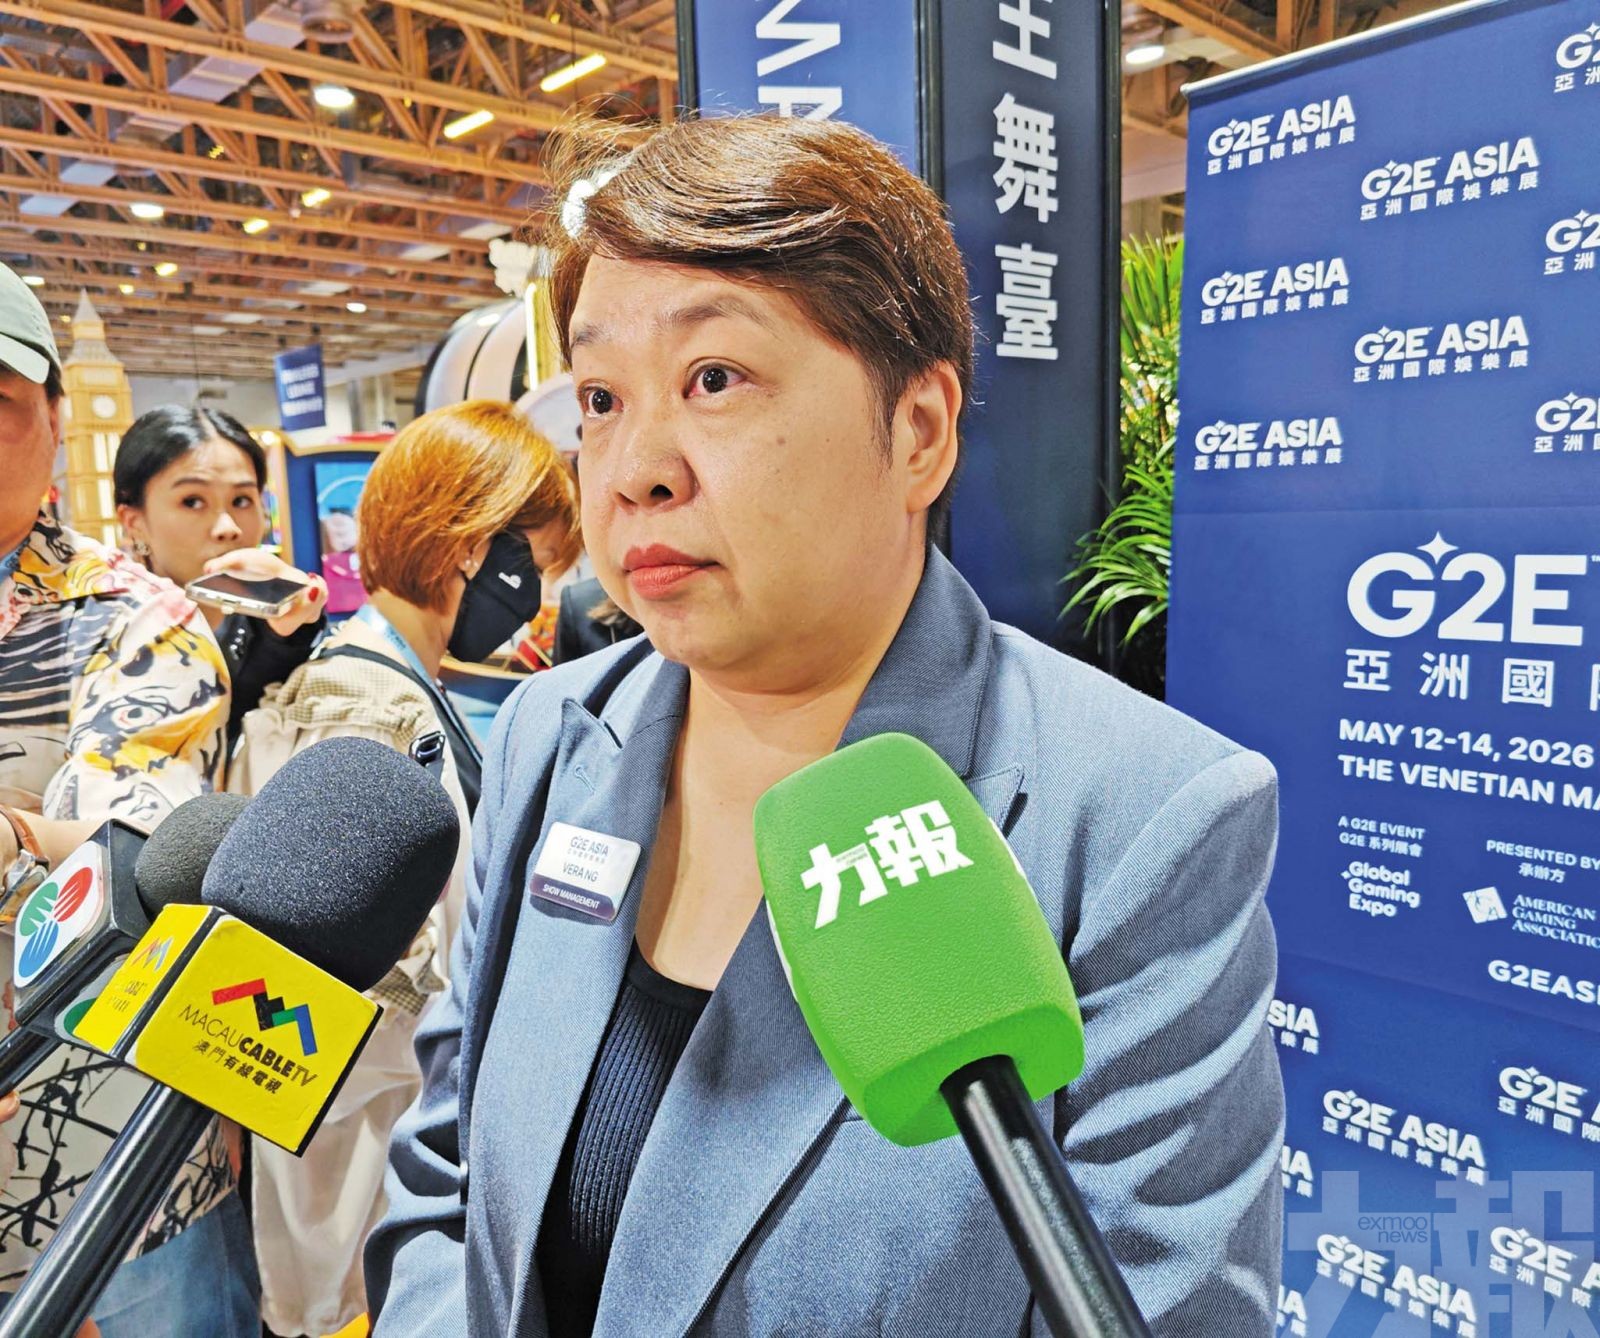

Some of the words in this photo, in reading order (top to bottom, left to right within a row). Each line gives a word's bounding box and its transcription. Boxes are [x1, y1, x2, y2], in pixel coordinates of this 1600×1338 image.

[1208, 115, 1274, 157] G2E
[1276, 95, 1357, 141] ASIA
[1361, 157, 1440, 201] G2E
[1444, 136, 1540, 185] ASIA
[1201, 271, 1267, 307] G2E
[1270, 257, 1349, 297] ASIA
[1354, 326, 1434, 364] G2E
[1436, 315, 1530, 356] ASIA
[1535, 391, 1600, 433] G2
[1195, 419, 1262, 454] G2E
[1263, 416, 1343, 450] ASIA
[1347, 550, 1588, 647] G2E
[1343, 648, 1600, 712] 亞洲國
[1339, 718, 1405, 747] MAY
[1410, 726, 1501, 763] 12-14,
[1508, 736, 1595, 769] 2026
[1337, 754, 1394, 782] THE
[1400, 762, 1555, 804] VENETIAN
[590, 841, 609, 857] ASIA
[1338, 815, 1350, 828] A
[1350, 817, 1377, 833] G2E
[1380, 821, 1426, 840] EVENT
[1339, 832, 1366, 848] G2E
[563, 862, 584, 879] VERA
[585, 870, 599, 883] NG
[800, 799, 975, 910] 力報
[1348, 861, 1411, 887] Global
[1486, 839, 1577, 866] PRESENTED
[1580, 856, 1600, 871] BY
[542, 883, 561, 896] SHOW
[560, 888, 601, 909] MANAGEMENT
[1348, 877, 1421, 909] Gaming
[1348, 893, 1397, 918] Expo
[1513, 894, 1597, 921] AMERICAN
[1512, 907, 1576, 930] GAMING
[1267, 999, 1320, 1039] SIA
[193, 1039, 283, 1094] 澳門有線電視
[1499, 1066, 1588, 1118] G2E
[1323, 1089, 1396, 1136] G2E
[1399, 1114, 1487, 1168] ASIA
[1490, 1226, 1577, 1282] G2E
[1316, 1234, 1390, 1285] G2E
[1391, 1264, 1477, 1323] ASIA
